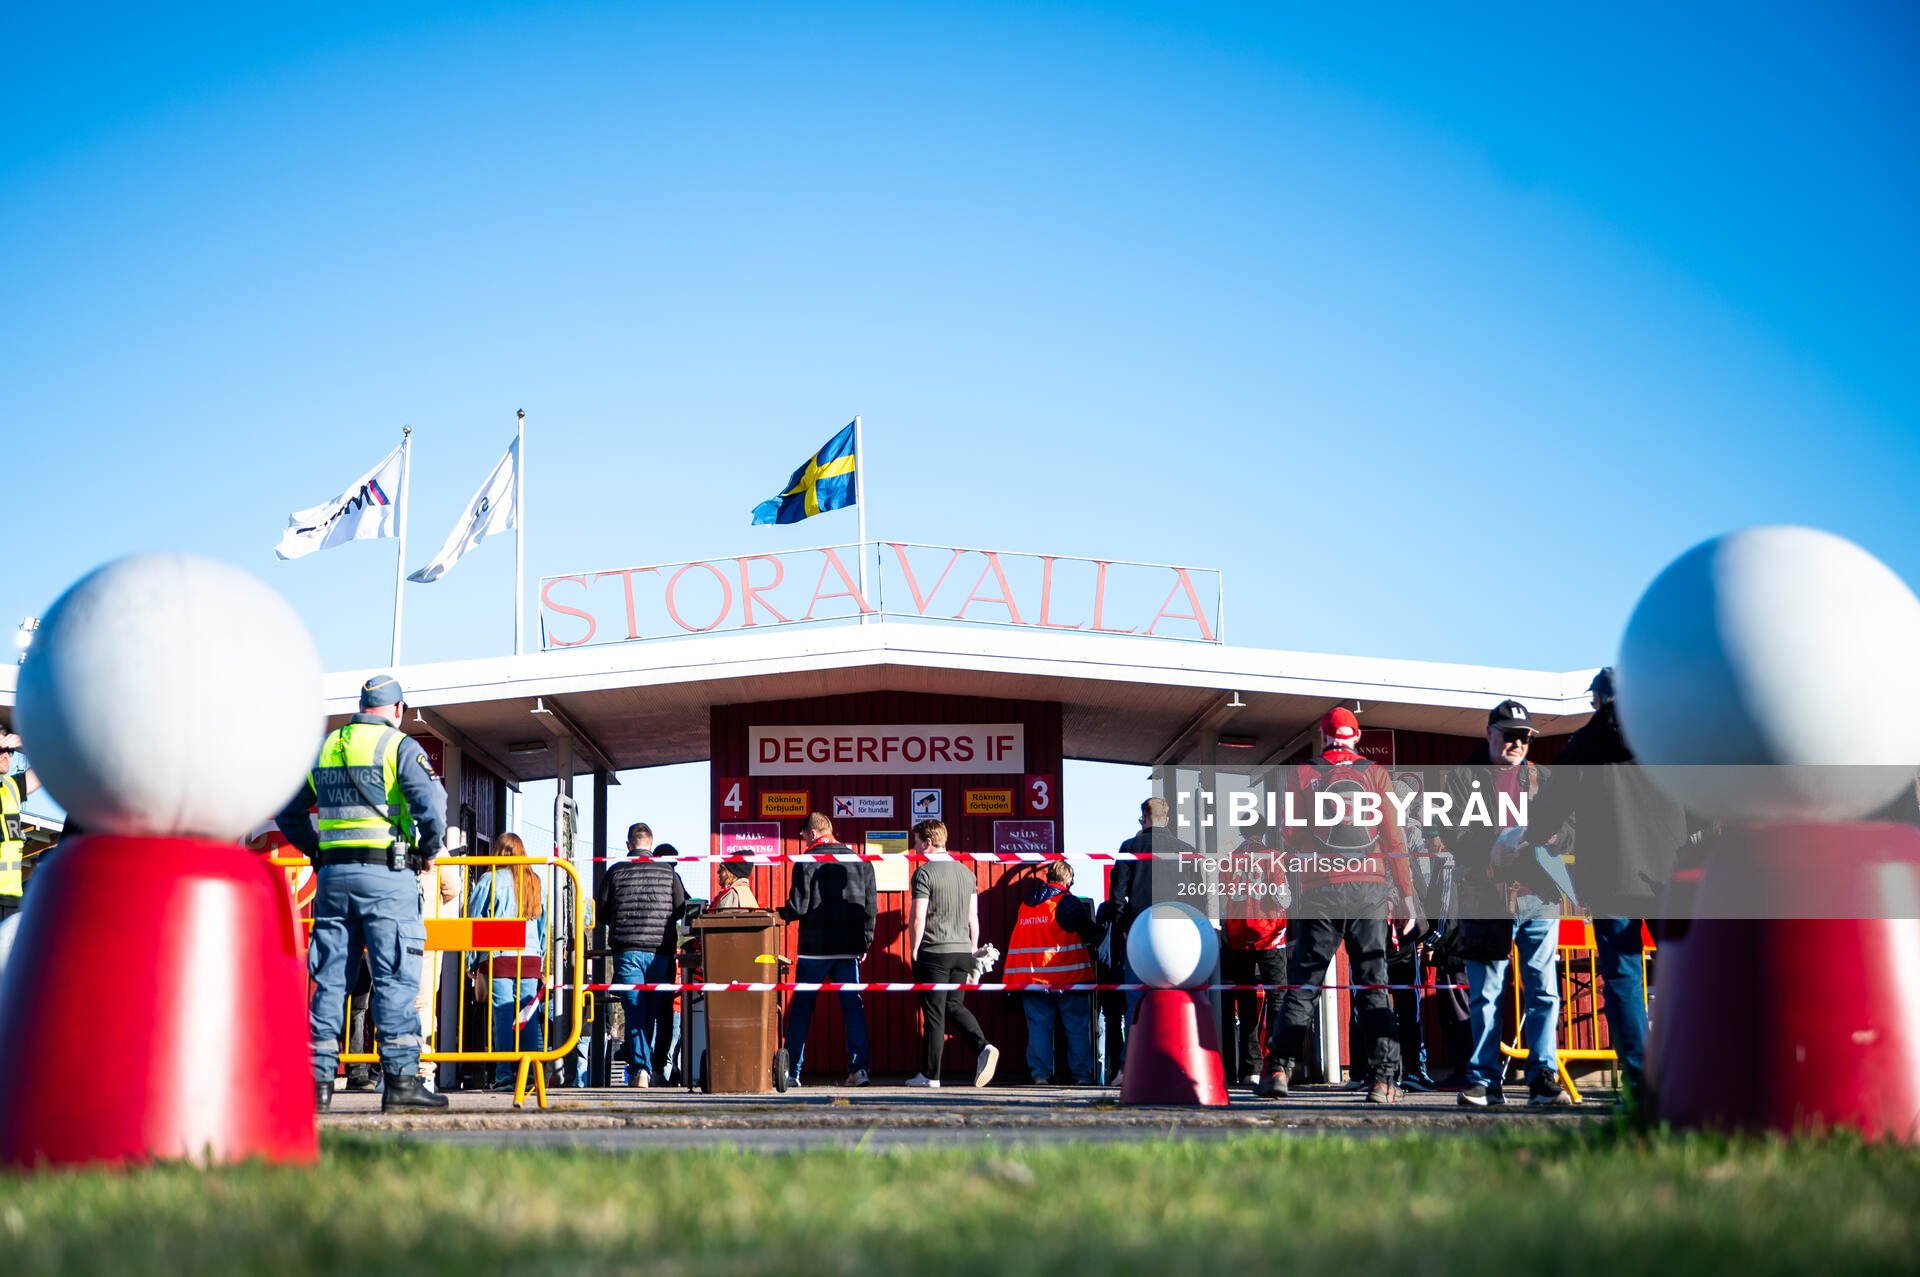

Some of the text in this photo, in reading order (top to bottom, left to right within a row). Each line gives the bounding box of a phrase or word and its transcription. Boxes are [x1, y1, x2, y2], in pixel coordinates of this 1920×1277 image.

[541, 541, 1218, 648] STORA VALLA
[759, 735, 1014, 763] DEGERFORS IF
[724, 783, 743, 812] 4
[768, 795, 802, 805] Rökning
[972, 792, 1006, 803] Rökning
[1031, 780, 1049, 810] 3
[765, 802, 805, 813] förbjuden
[859, 799, 888, 808] Förbjudet
[969, 800, 1009, 811] förbjuden
